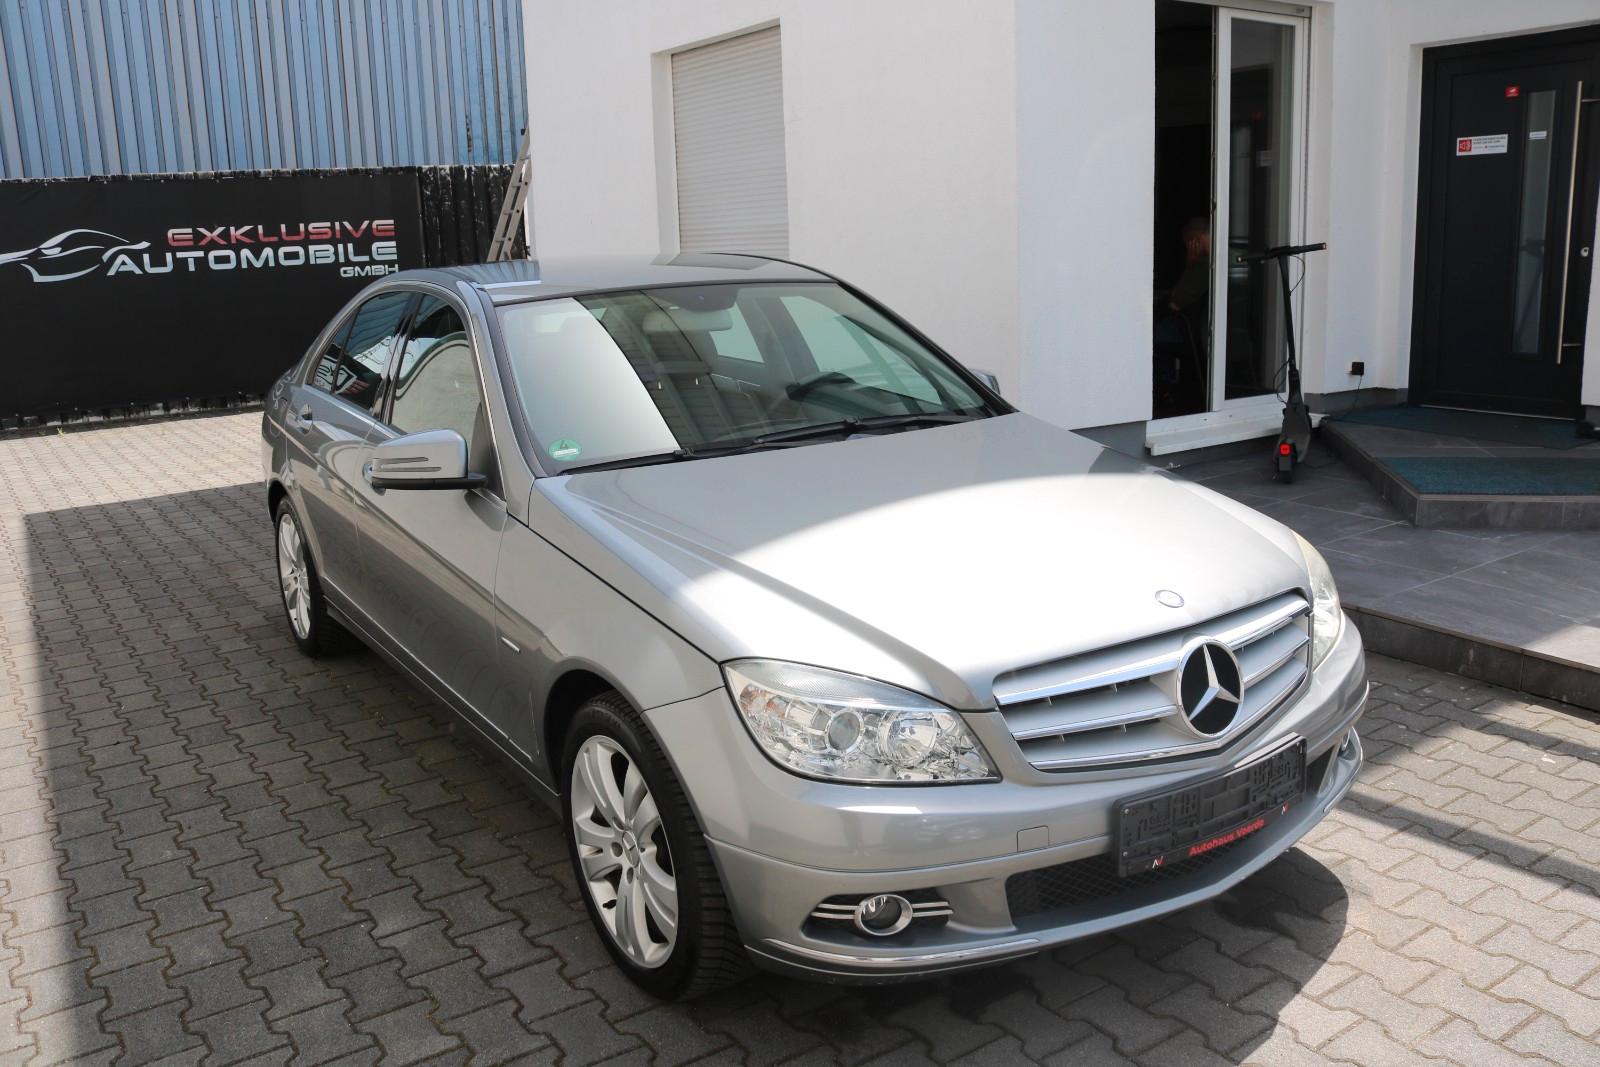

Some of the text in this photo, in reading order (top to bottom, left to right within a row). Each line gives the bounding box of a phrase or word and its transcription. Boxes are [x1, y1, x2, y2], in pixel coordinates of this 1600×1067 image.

[167, 219, 395, 247] EXKLUSIVE
[106, 241, 397, 276] AUTOMOBILE
[340, 263, 399, 278] GMBH
[1188, 833, 1234, 858] Autohaus
